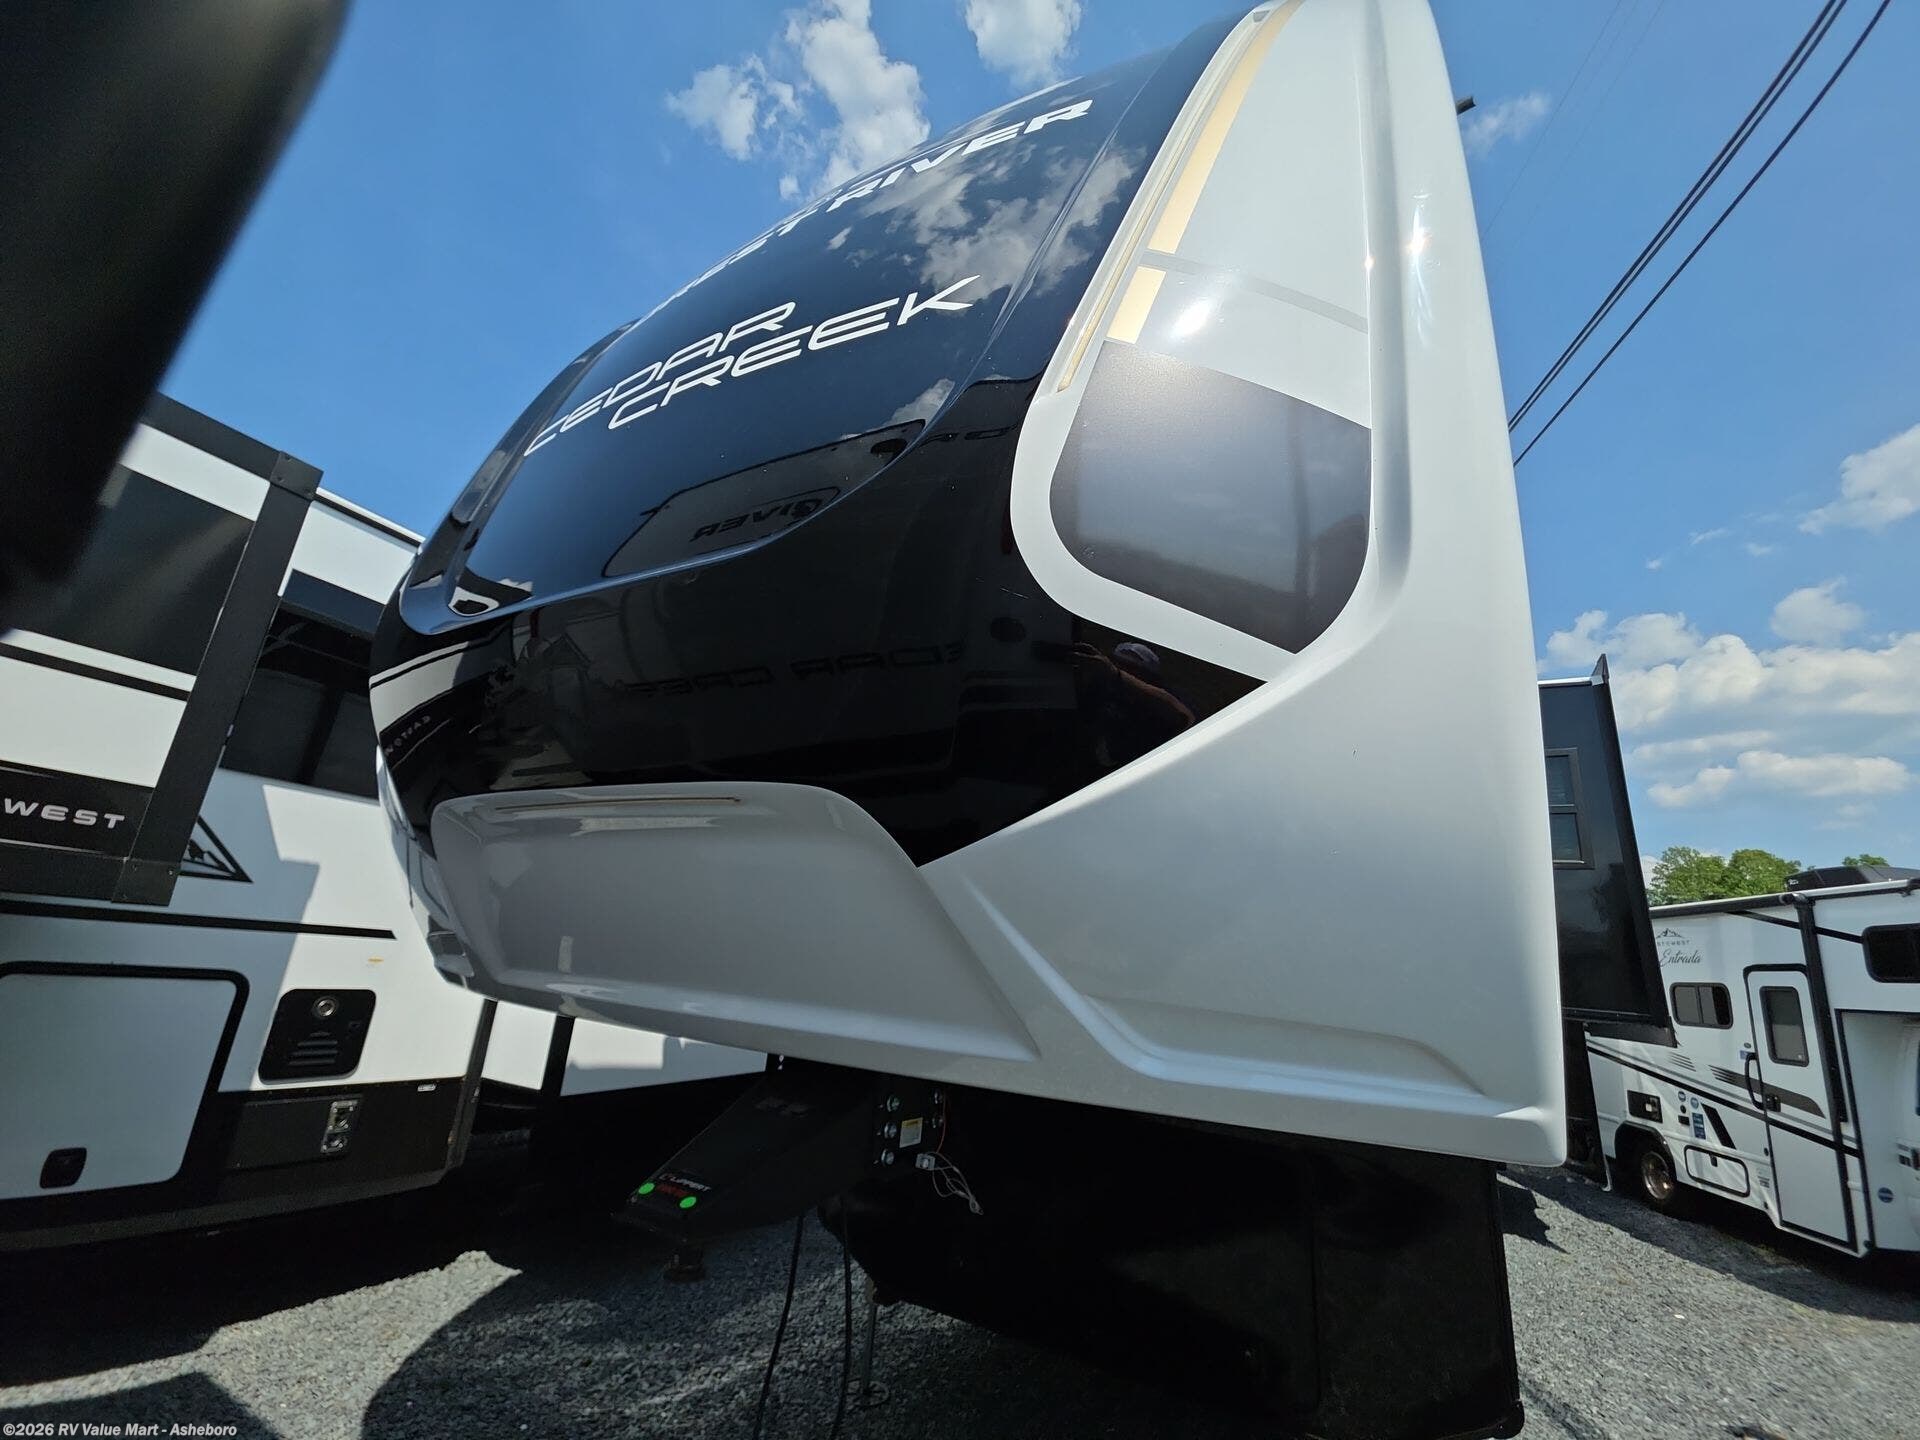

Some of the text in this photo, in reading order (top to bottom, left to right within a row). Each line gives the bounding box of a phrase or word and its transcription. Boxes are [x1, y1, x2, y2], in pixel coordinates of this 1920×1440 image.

[826, 99, 1093, 213] RIVER
[524, 301, 796, 457] CEDAR
[608, 275, 981, 430] CREEK
[4, 798, 125, 829] WEST
